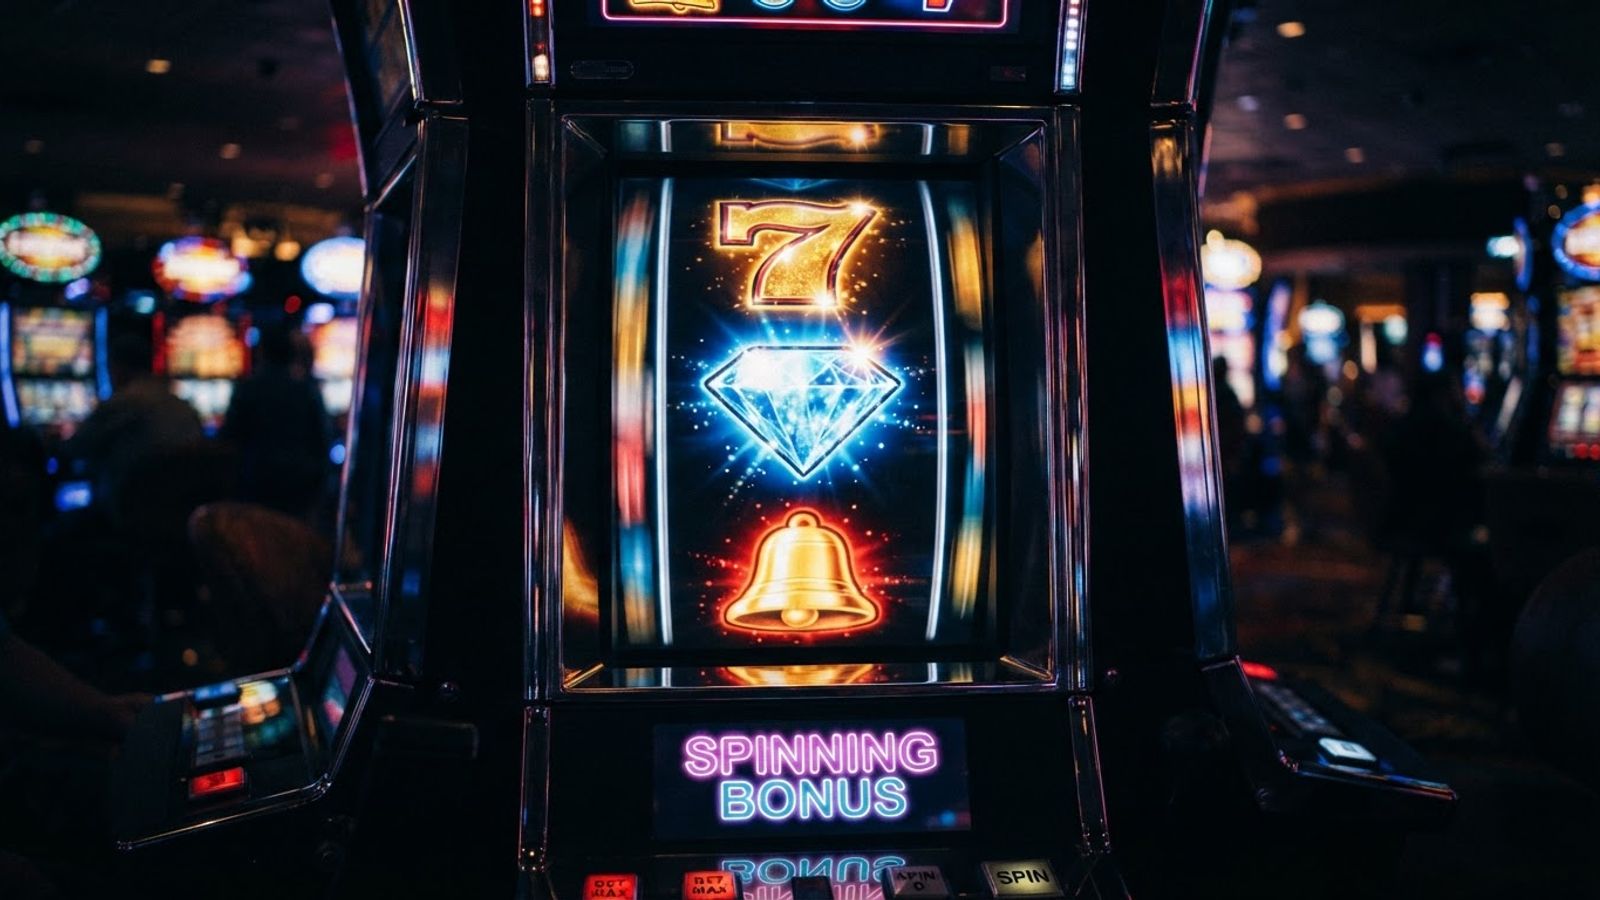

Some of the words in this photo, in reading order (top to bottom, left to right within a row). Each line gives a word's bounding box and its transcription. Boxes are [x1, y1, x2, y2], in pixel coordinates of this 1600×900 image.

[718, 200, 877, 308] 7
[684, 731, 938, 777] SPINNING
[720, 776, 908, 820] BONUS
[996, 869, 1051, 885] SPIN
